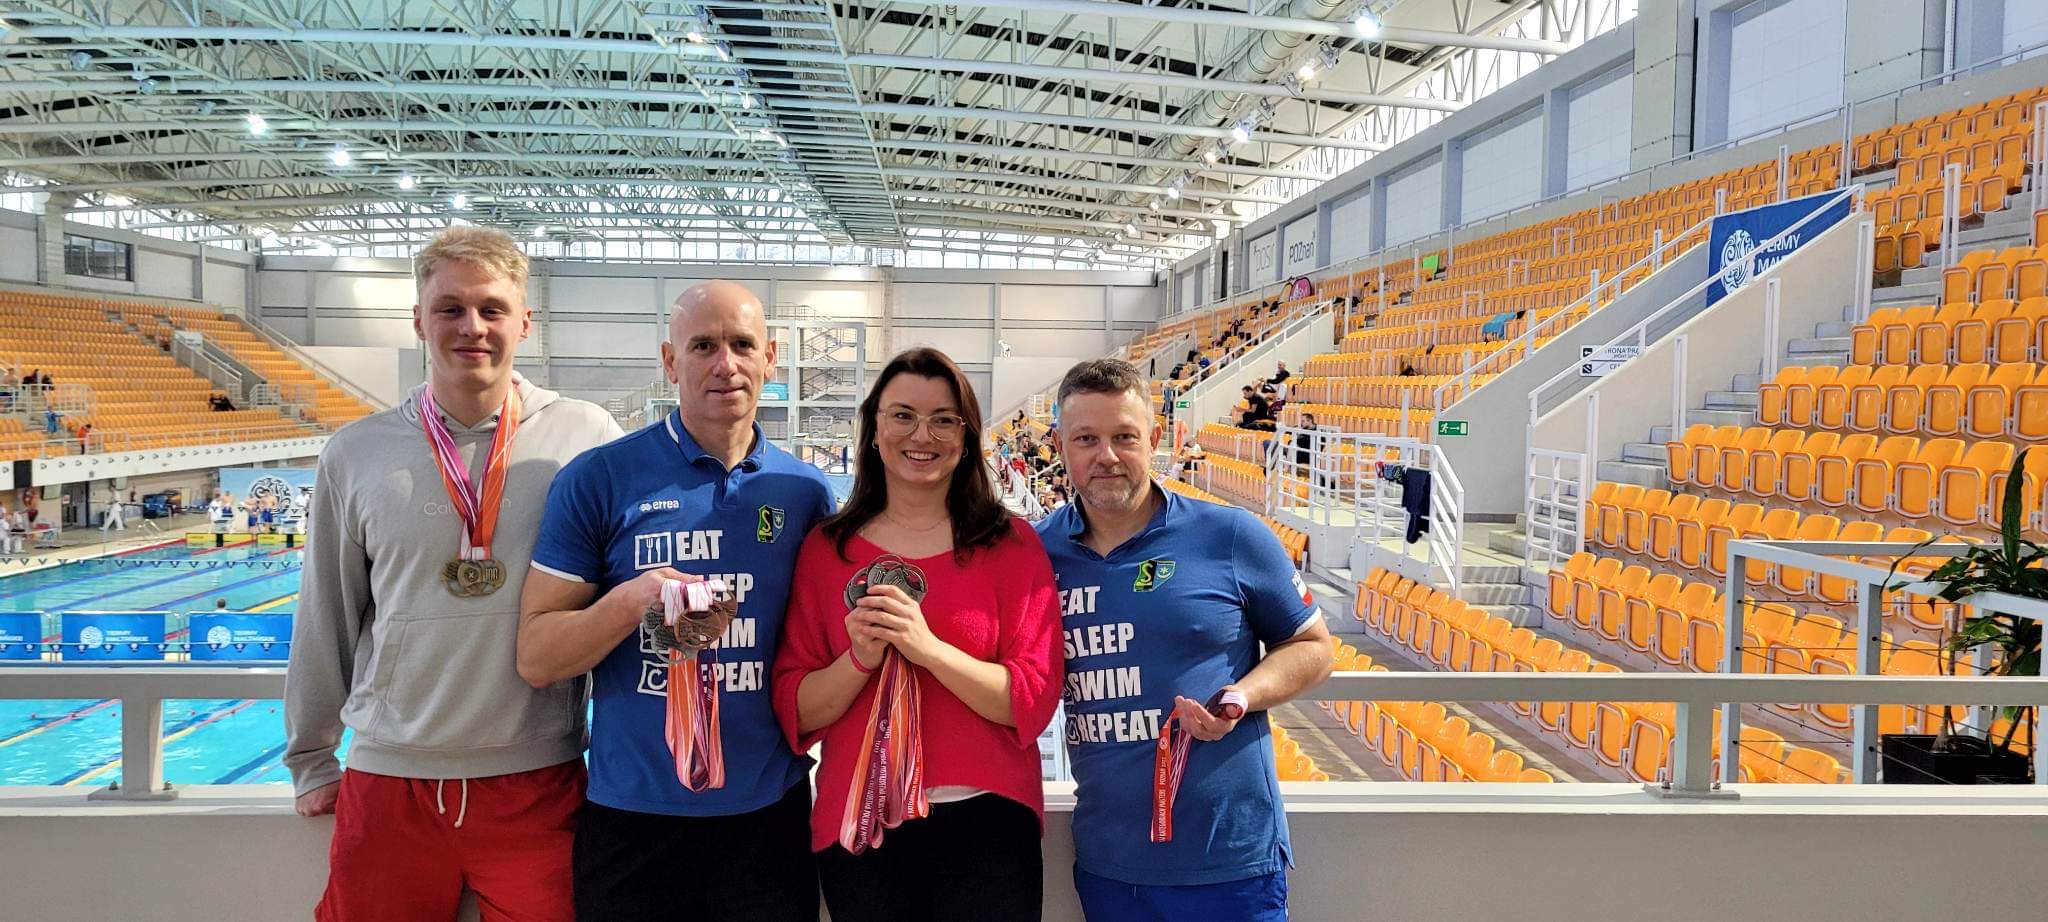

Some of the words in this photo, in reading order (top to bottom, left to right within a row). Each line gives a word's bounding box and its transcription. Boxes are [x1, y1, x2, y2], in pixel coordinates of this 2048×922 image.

[675, 530, 723, 561] EAT
[1057, 585, 1101, 617] EAT
[1062, 622, 1135, 660] SLEEP
[701, 661, 764, 693] EPEAT
[1067, 666, 1142, 702] SWIM
[1077, 708, 1162, 743] REPEAT
